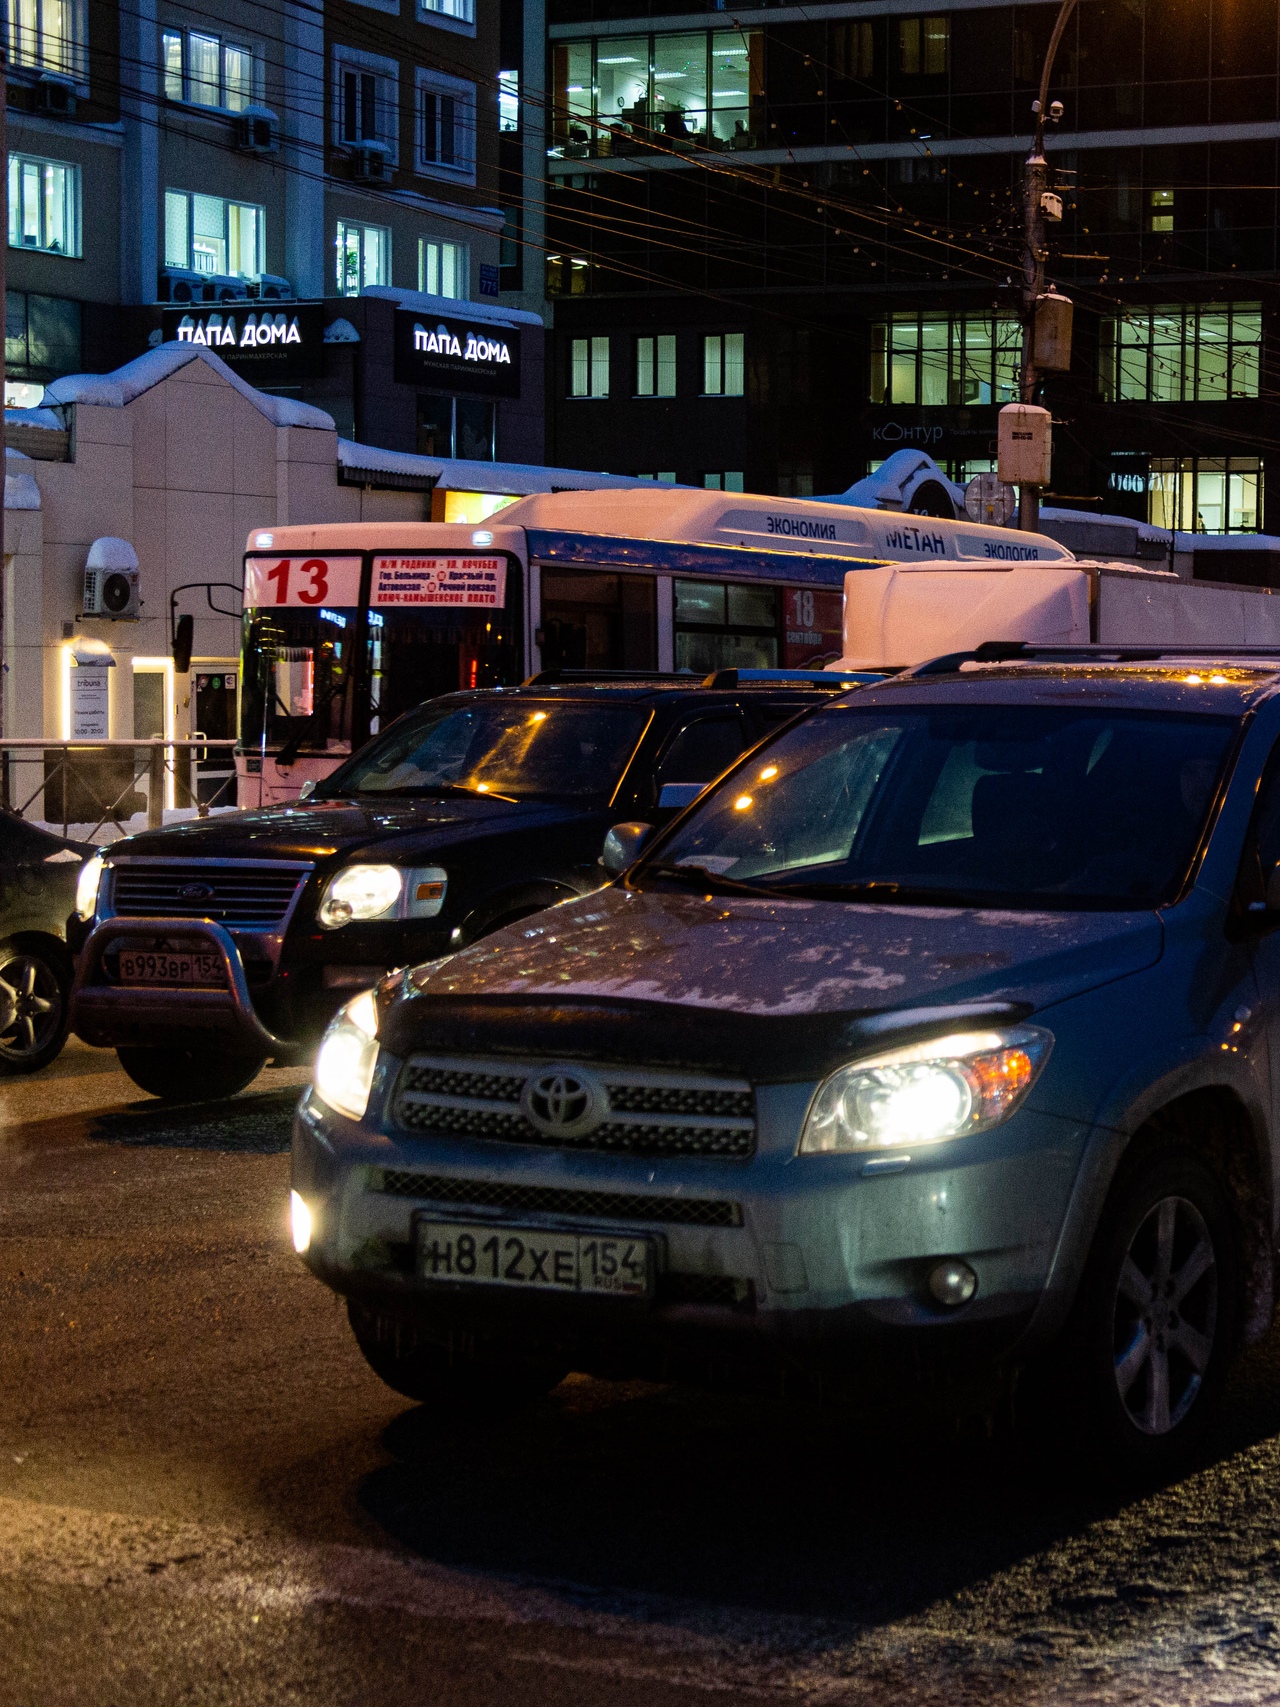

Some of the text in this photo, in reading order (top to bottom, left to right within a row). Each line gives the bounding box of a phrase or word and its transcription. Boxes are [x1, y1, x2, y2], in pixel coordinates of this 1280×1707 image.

[178, 323, 302, 347] ПАПА ДОМА
[226, 352, 288, 361] ПАРИКМАХЕРСКАЯ
[414, 330, 511, 364] ПАПА ДОМА
[423, 360, 497, 376] МУЖСКАЯ ПАРИКМАХЕРСКАЯ
[767, 516, 837, 541] ЭКОНОМИЯ
[886, 527, 946, 555] МЕТАН
[984, 543, 1039, 561] ЭКОЛОГИЯ
[401, 560, 436, 570] РОДНИКИ
[462, 560, 498, 569] КОЧУБЕЯ
[267, 559, 329, 604] 13
[394, 571, 430, 580] Больница
[449, 571, 483, 581] Красный
[378, 582, 496, 592] Автовокзал Речной вокзал
[467, 594, 496, 603] ПЛАТО
[793, 590, 814, 627] 18
[78, 679, 100, 687] tribuna
[125, 955, 223, 979] В993ВР 154
[431, 1233, 643, 1284] Н812ХЕ 154
